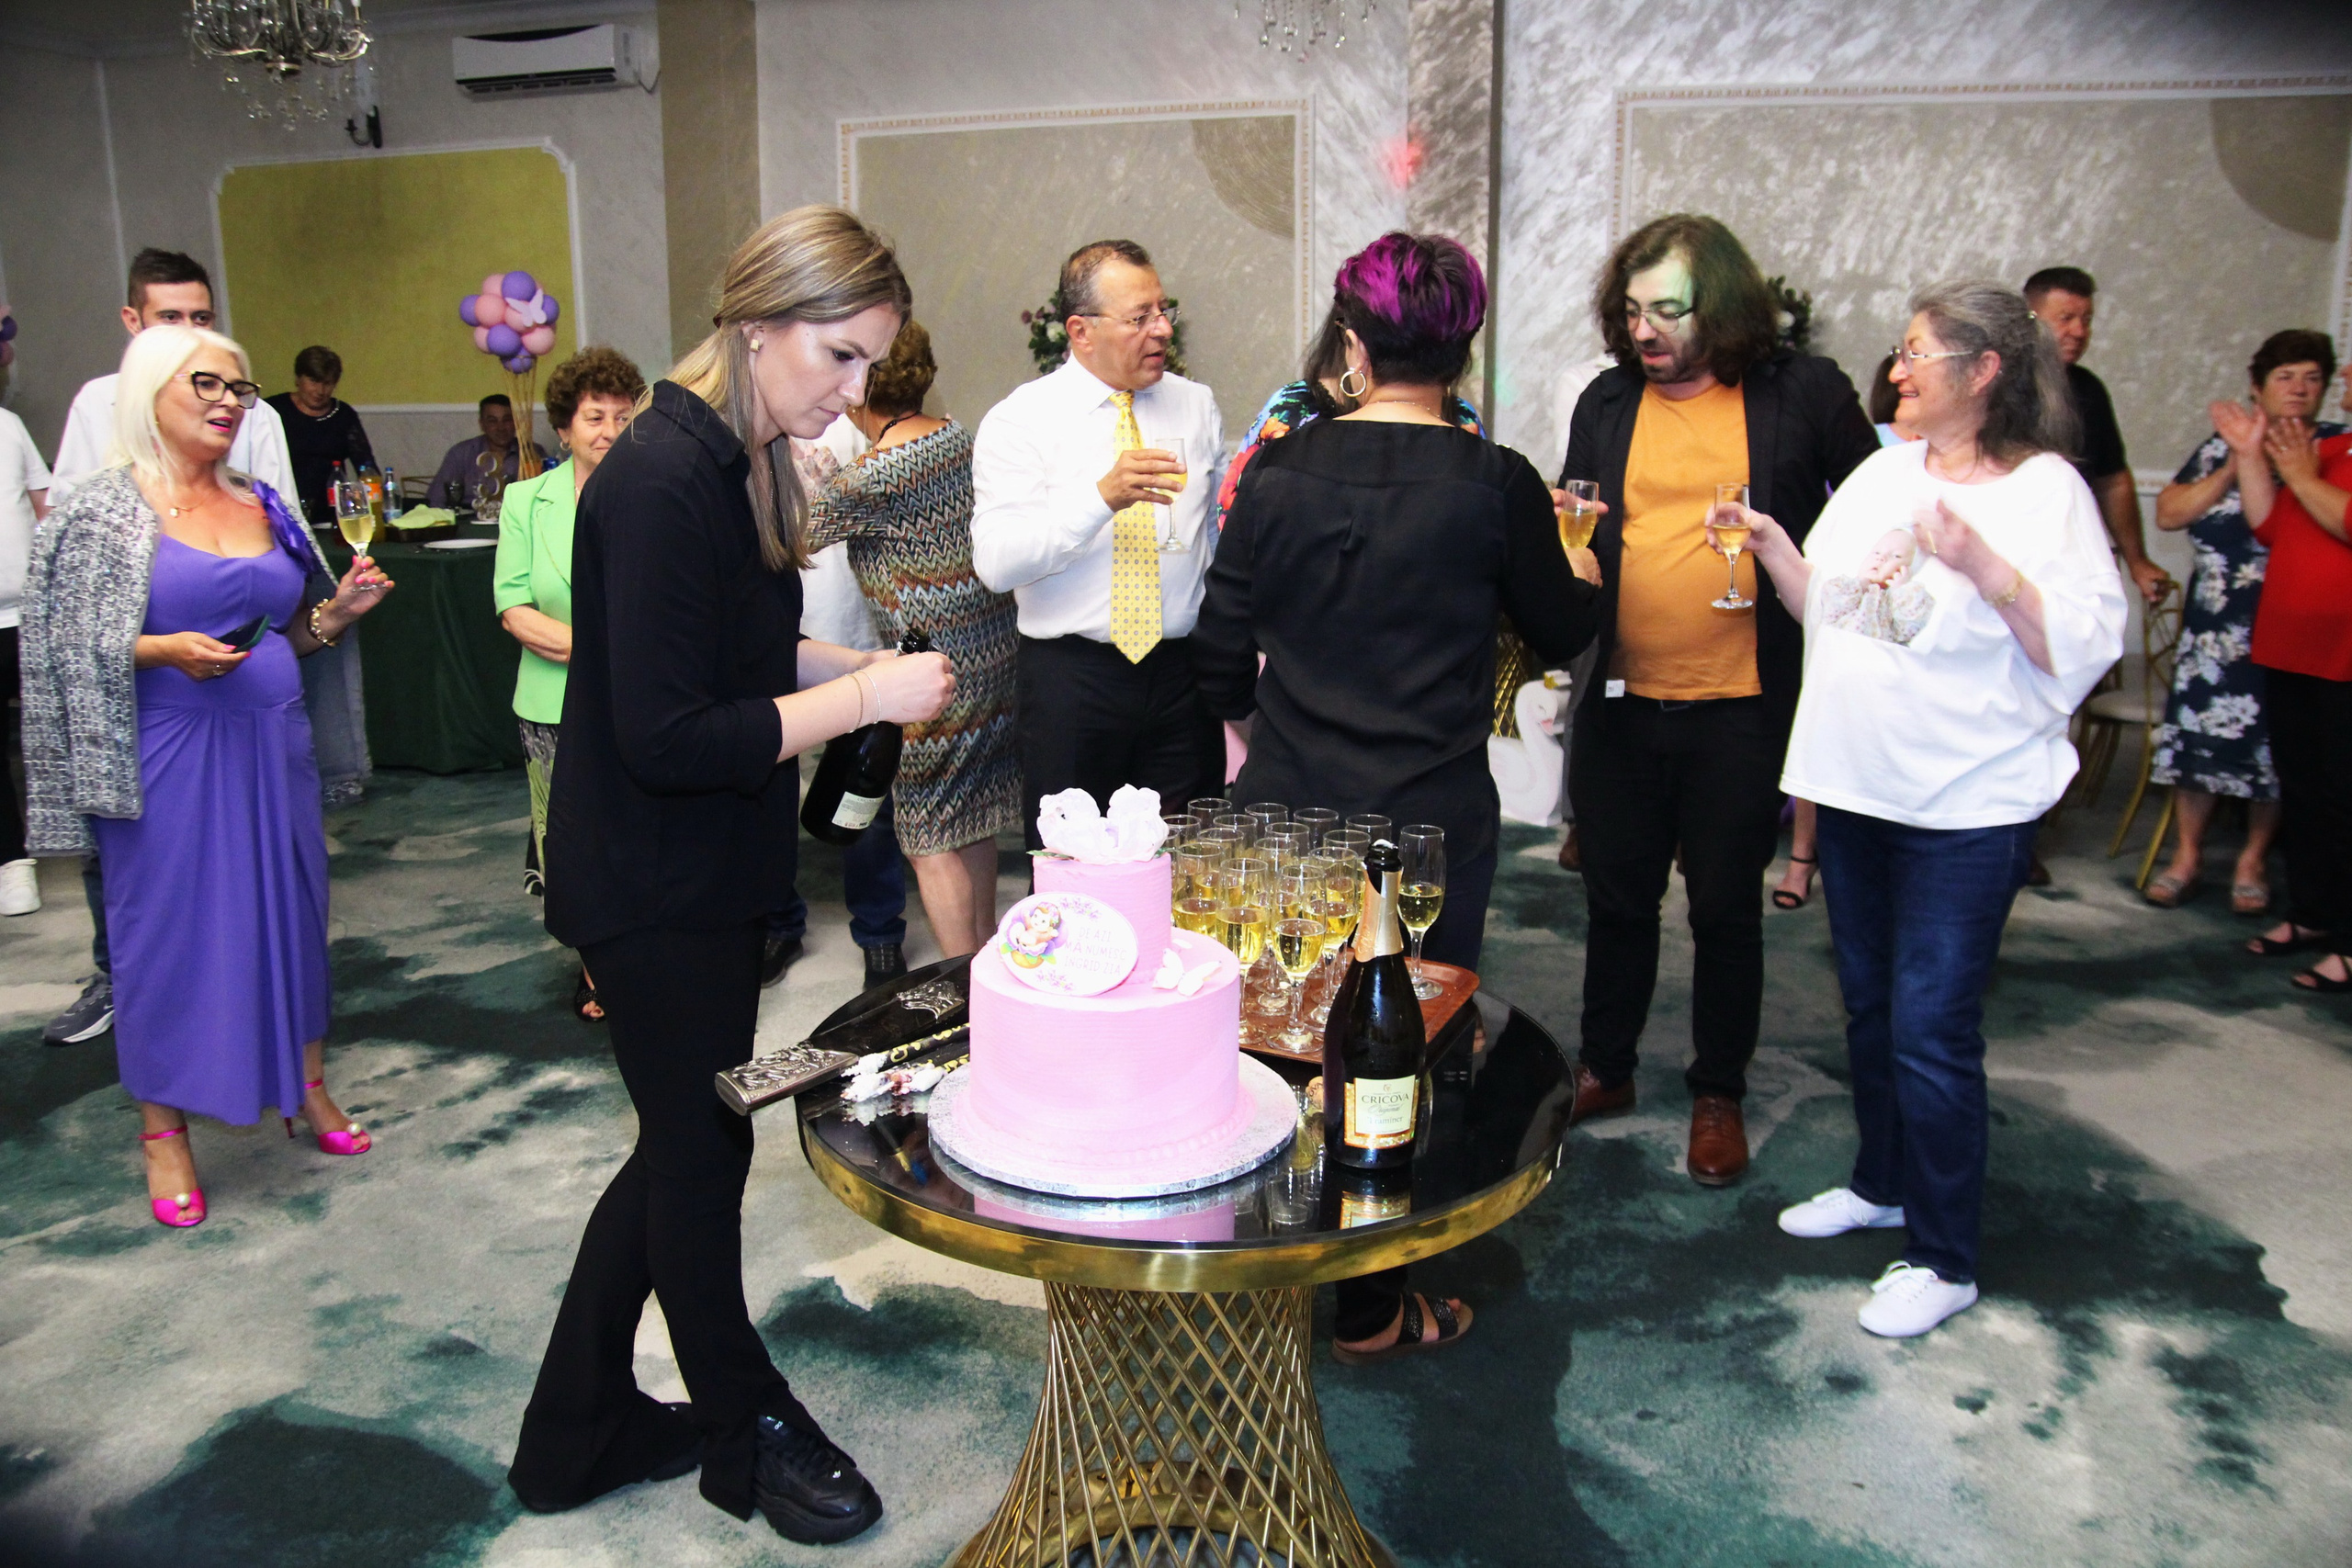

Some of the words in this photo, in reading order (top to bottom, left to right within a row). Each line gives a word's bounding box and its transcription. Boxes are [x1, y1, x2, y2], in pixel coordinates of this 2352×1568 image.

[1080, 927, 1091, 939] DE
[1094, 930, 1112, 942] AZI
[1086, 945, 1127, 961] NUMESC
[1064, 956, 1101, 972] INGRID
[1362, 1093, 1409, 1104] CRICOVA
